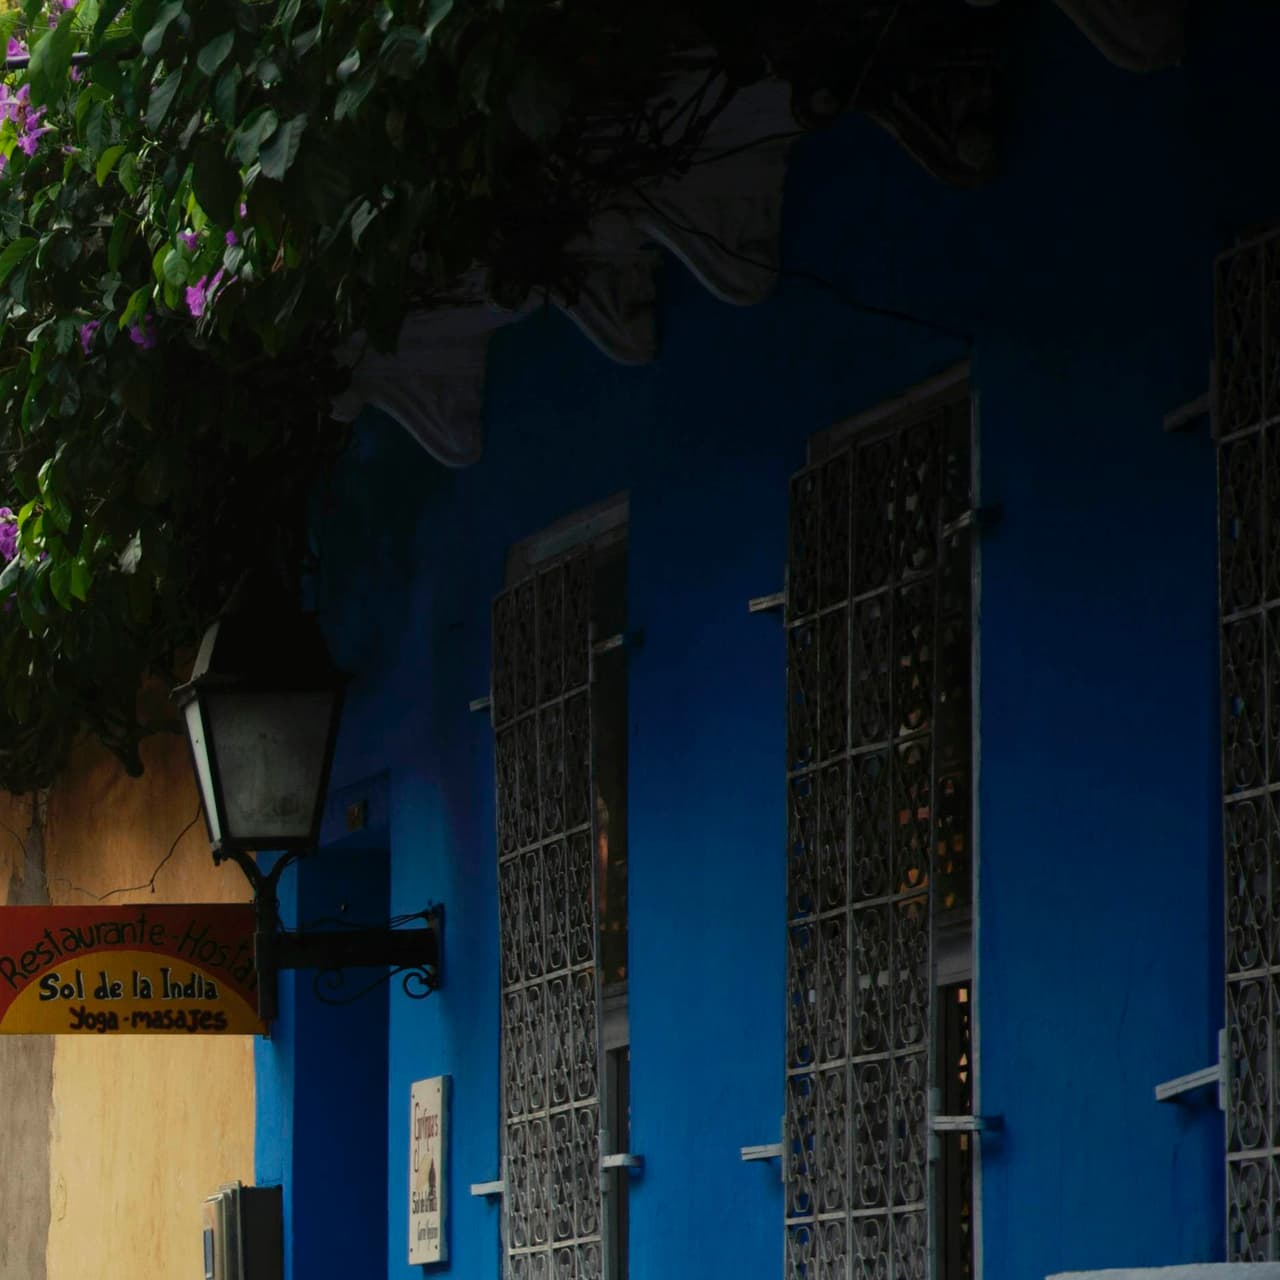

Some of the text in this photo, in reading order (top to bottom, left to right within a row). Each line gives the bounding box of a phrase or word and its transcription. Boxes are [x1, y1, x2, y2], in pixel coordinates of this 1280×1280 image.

[39, 967, 219, 1001] Sol de la India
